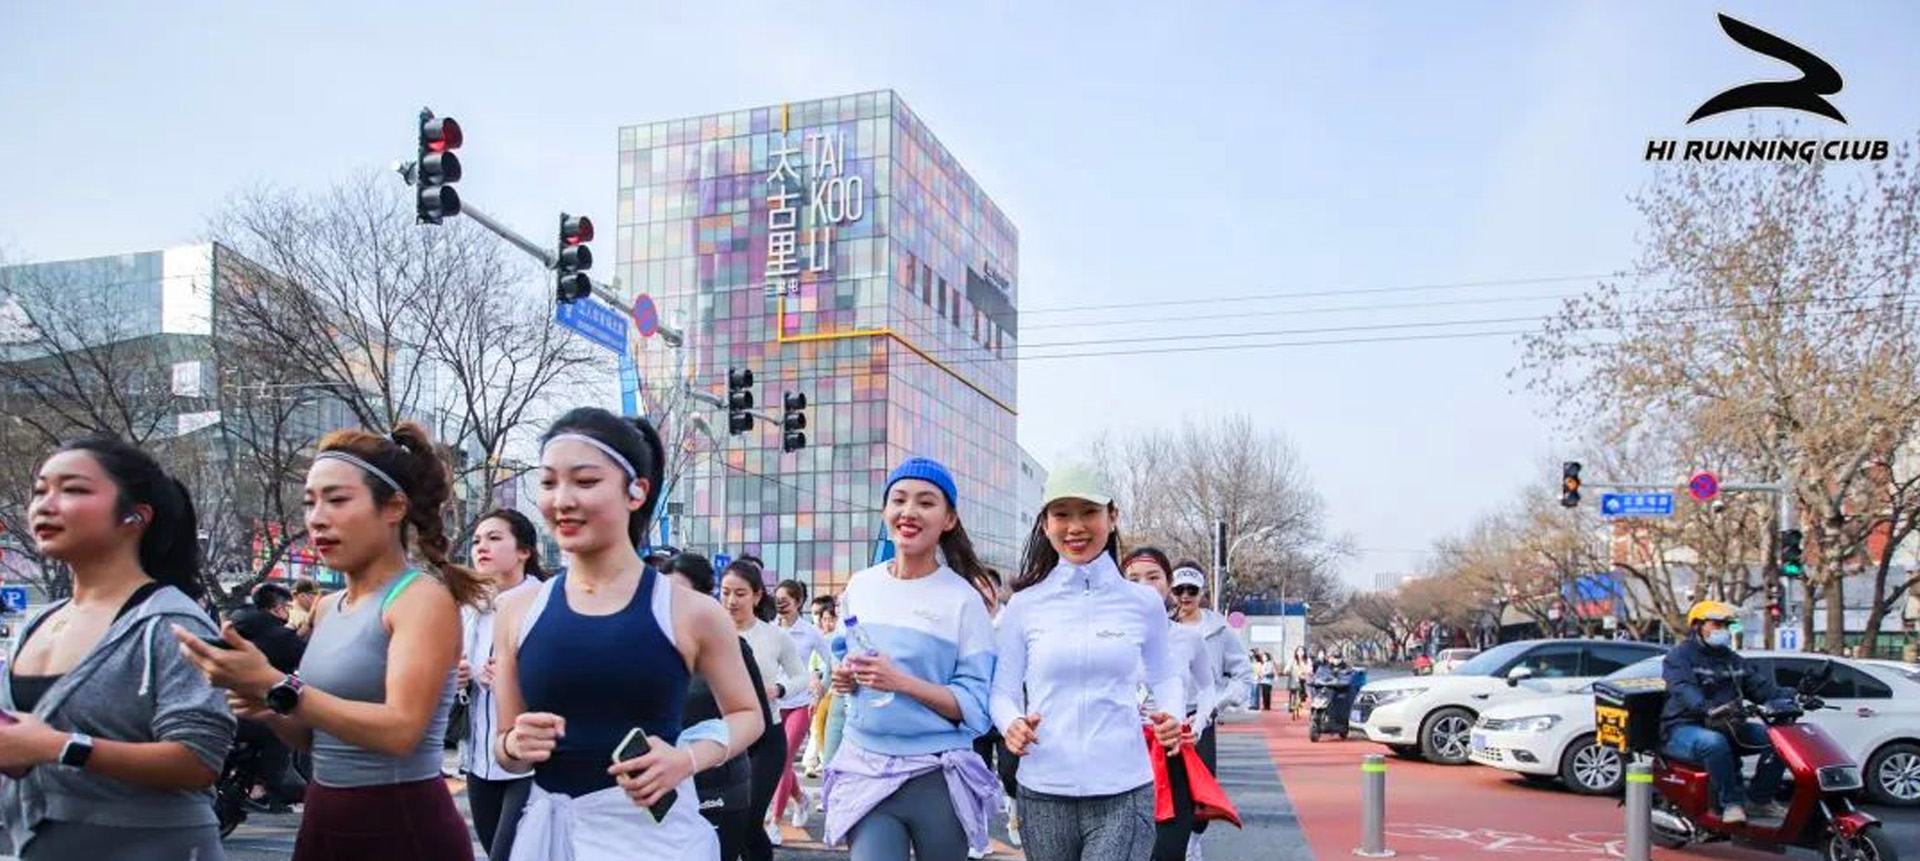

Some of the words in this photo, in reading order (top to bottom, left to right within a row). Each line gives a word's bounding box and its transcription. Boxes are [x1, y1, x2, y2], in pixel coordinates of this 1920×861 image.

[808, 132, 845, 178] TAI
[766, 137, 800, 276] 太古里
[810, 176, 863, 225] KOO
[809, 226, 830, 272] LI
[7, 591, 22, 608] P
